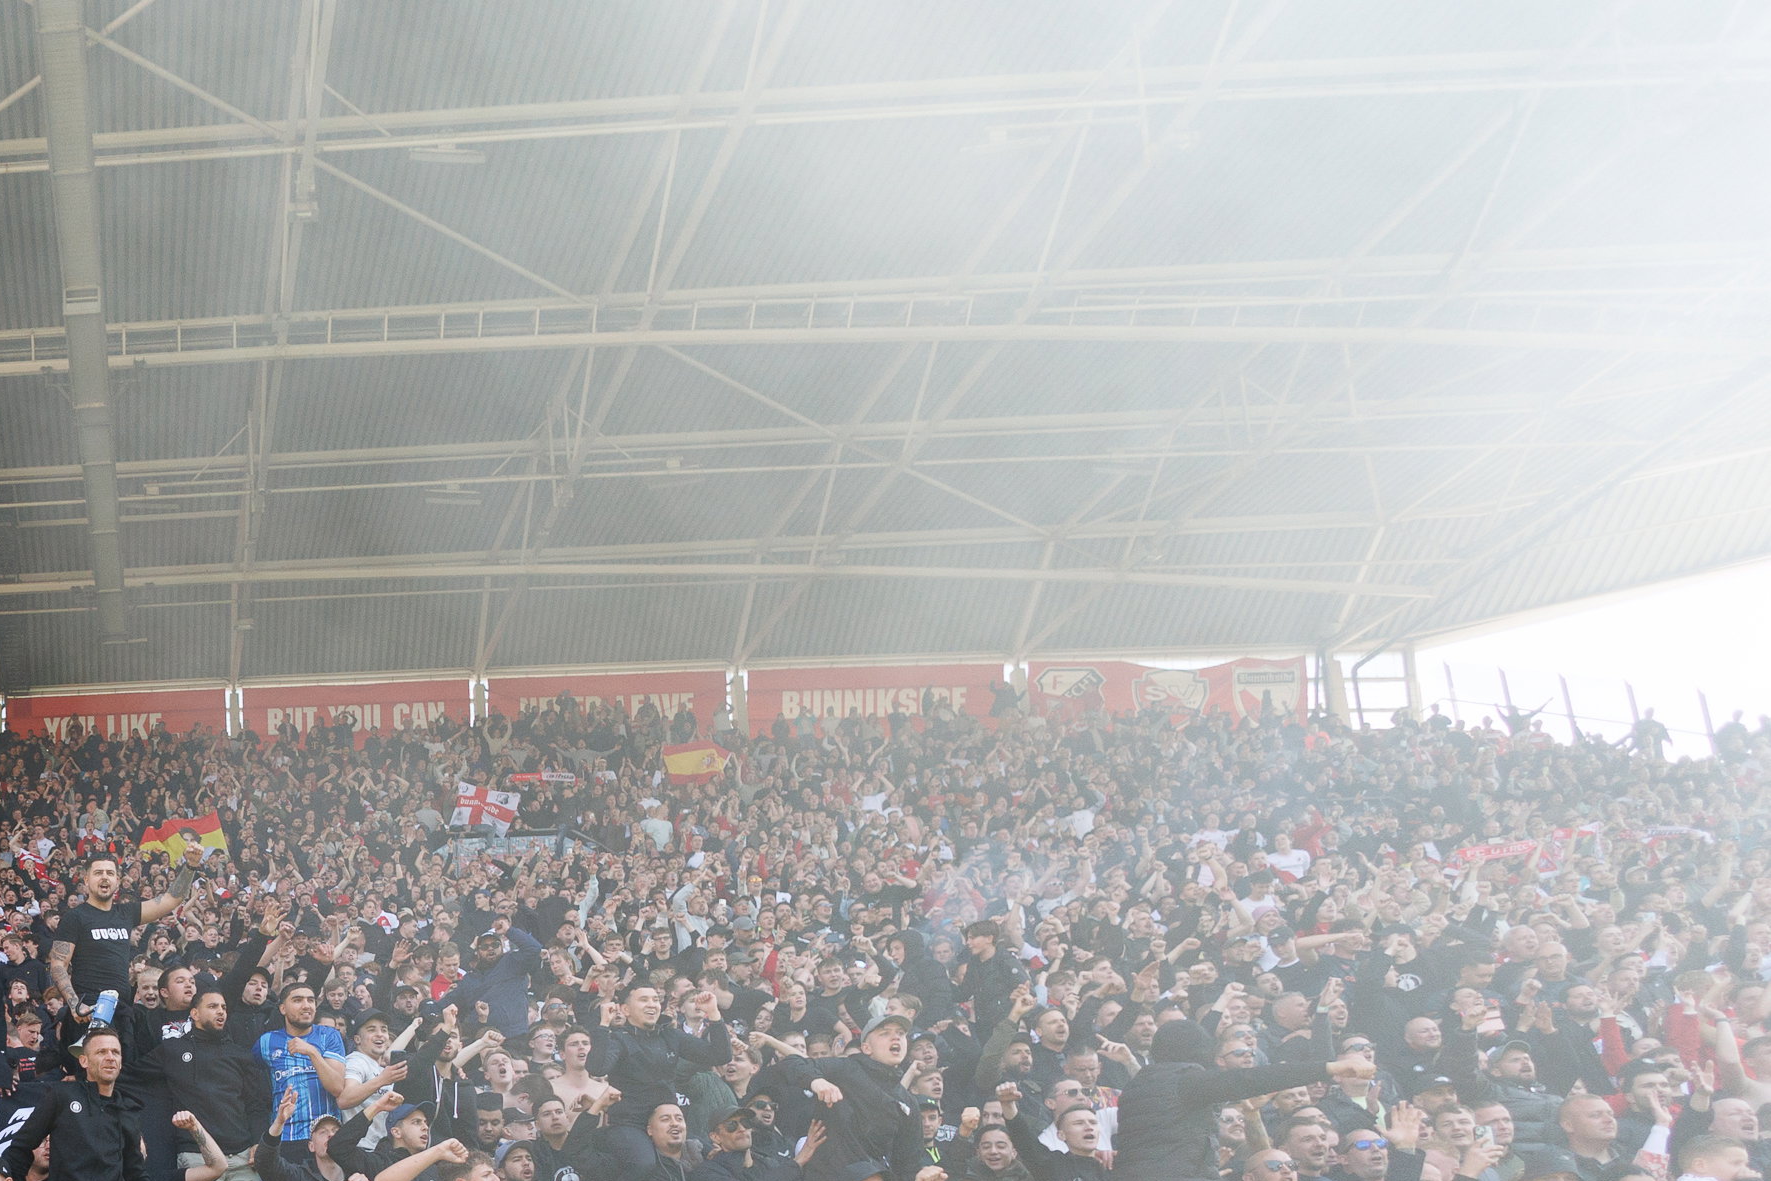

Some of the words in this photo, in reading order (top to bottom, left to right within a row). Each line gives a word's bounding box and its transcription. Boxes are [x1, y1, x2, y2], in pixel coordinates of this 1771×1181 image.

[267, 707, 318, 735] BUT
[327, 704, 381, 732] YOU
[392, 702, 445, 730] CAN
[520, 696, 602, 718] NEER
